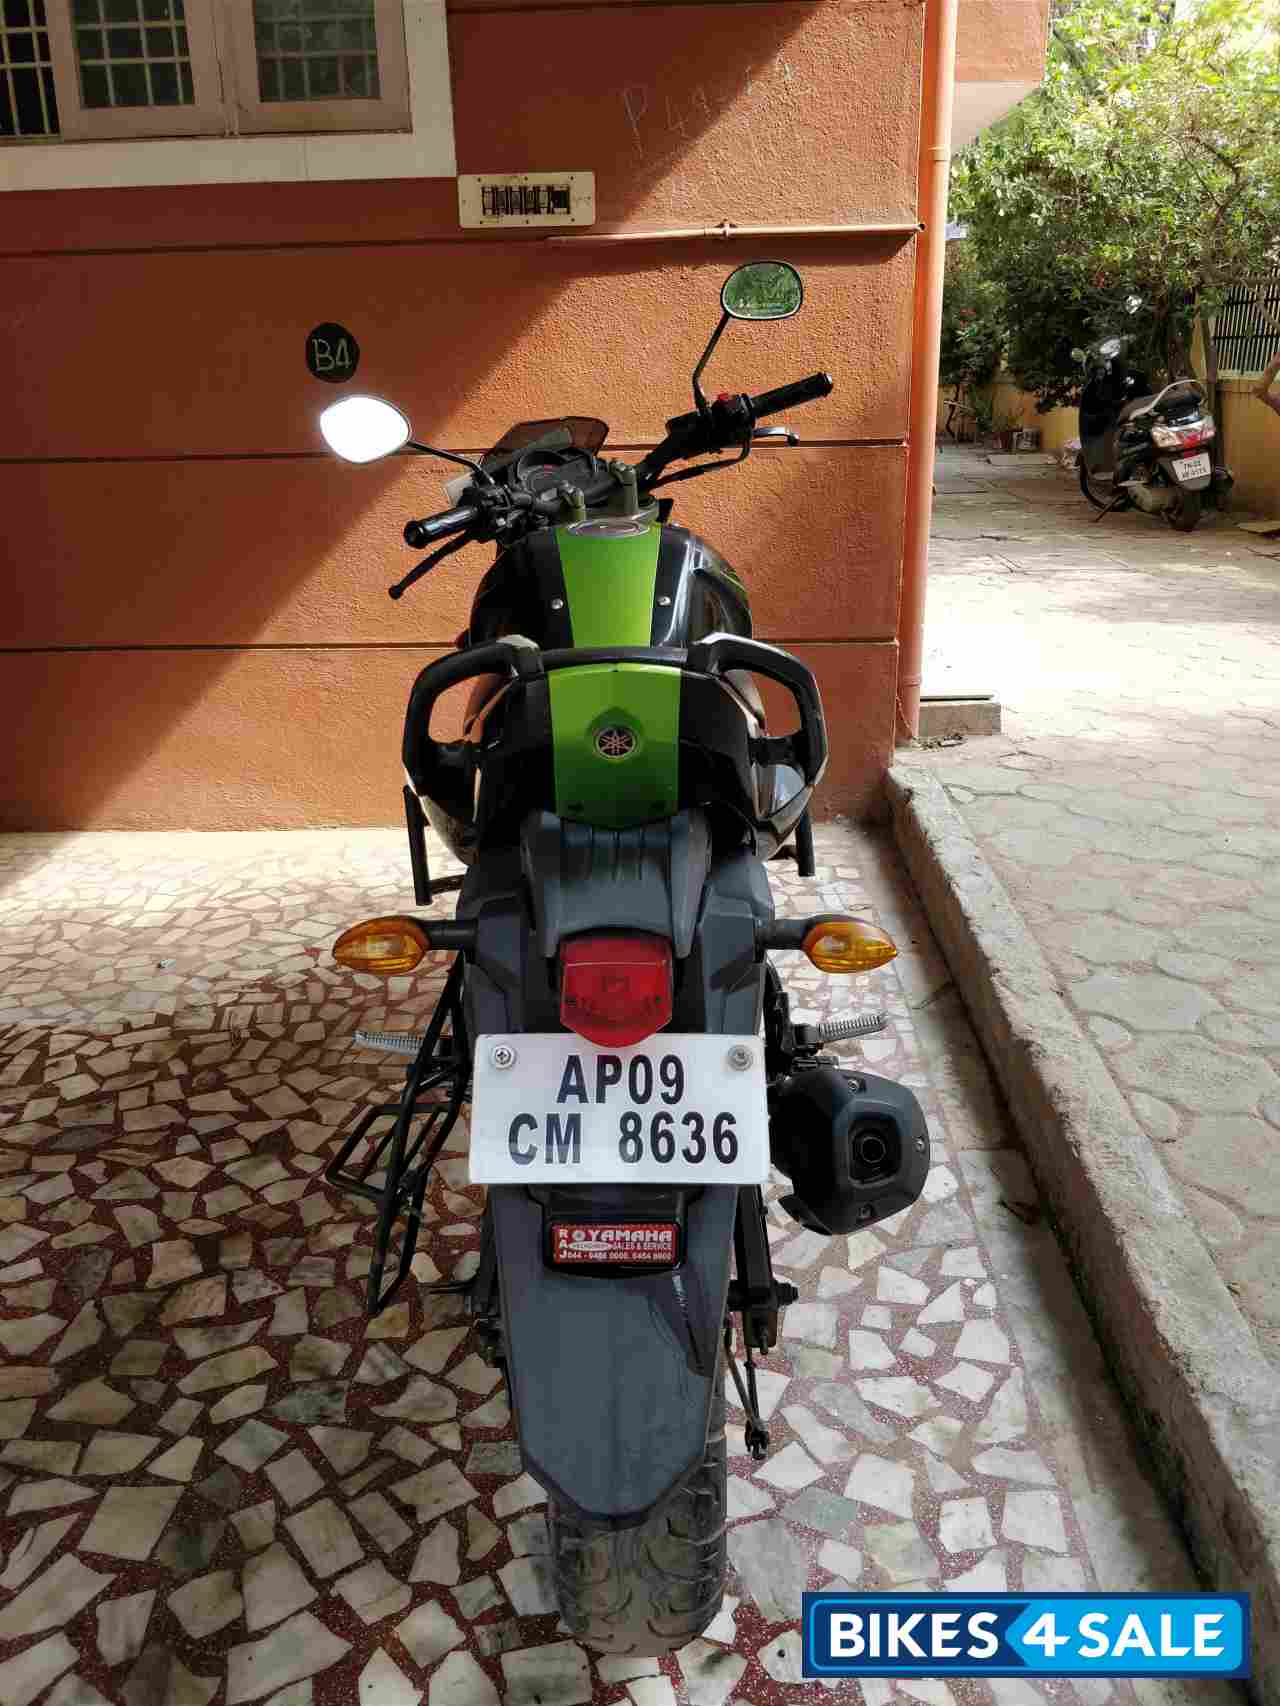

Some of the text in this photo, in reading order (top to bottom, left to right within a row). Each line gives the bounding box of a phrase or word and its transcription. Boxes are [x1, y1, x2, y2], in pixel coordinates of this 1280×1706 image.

[312, 338, 352, 371] B4
[556, 1054, 685, 1105] AP09
[508, 1111, 739, 1165] CM 8636
[587, 1230, 672, 1242] YAMAHA
